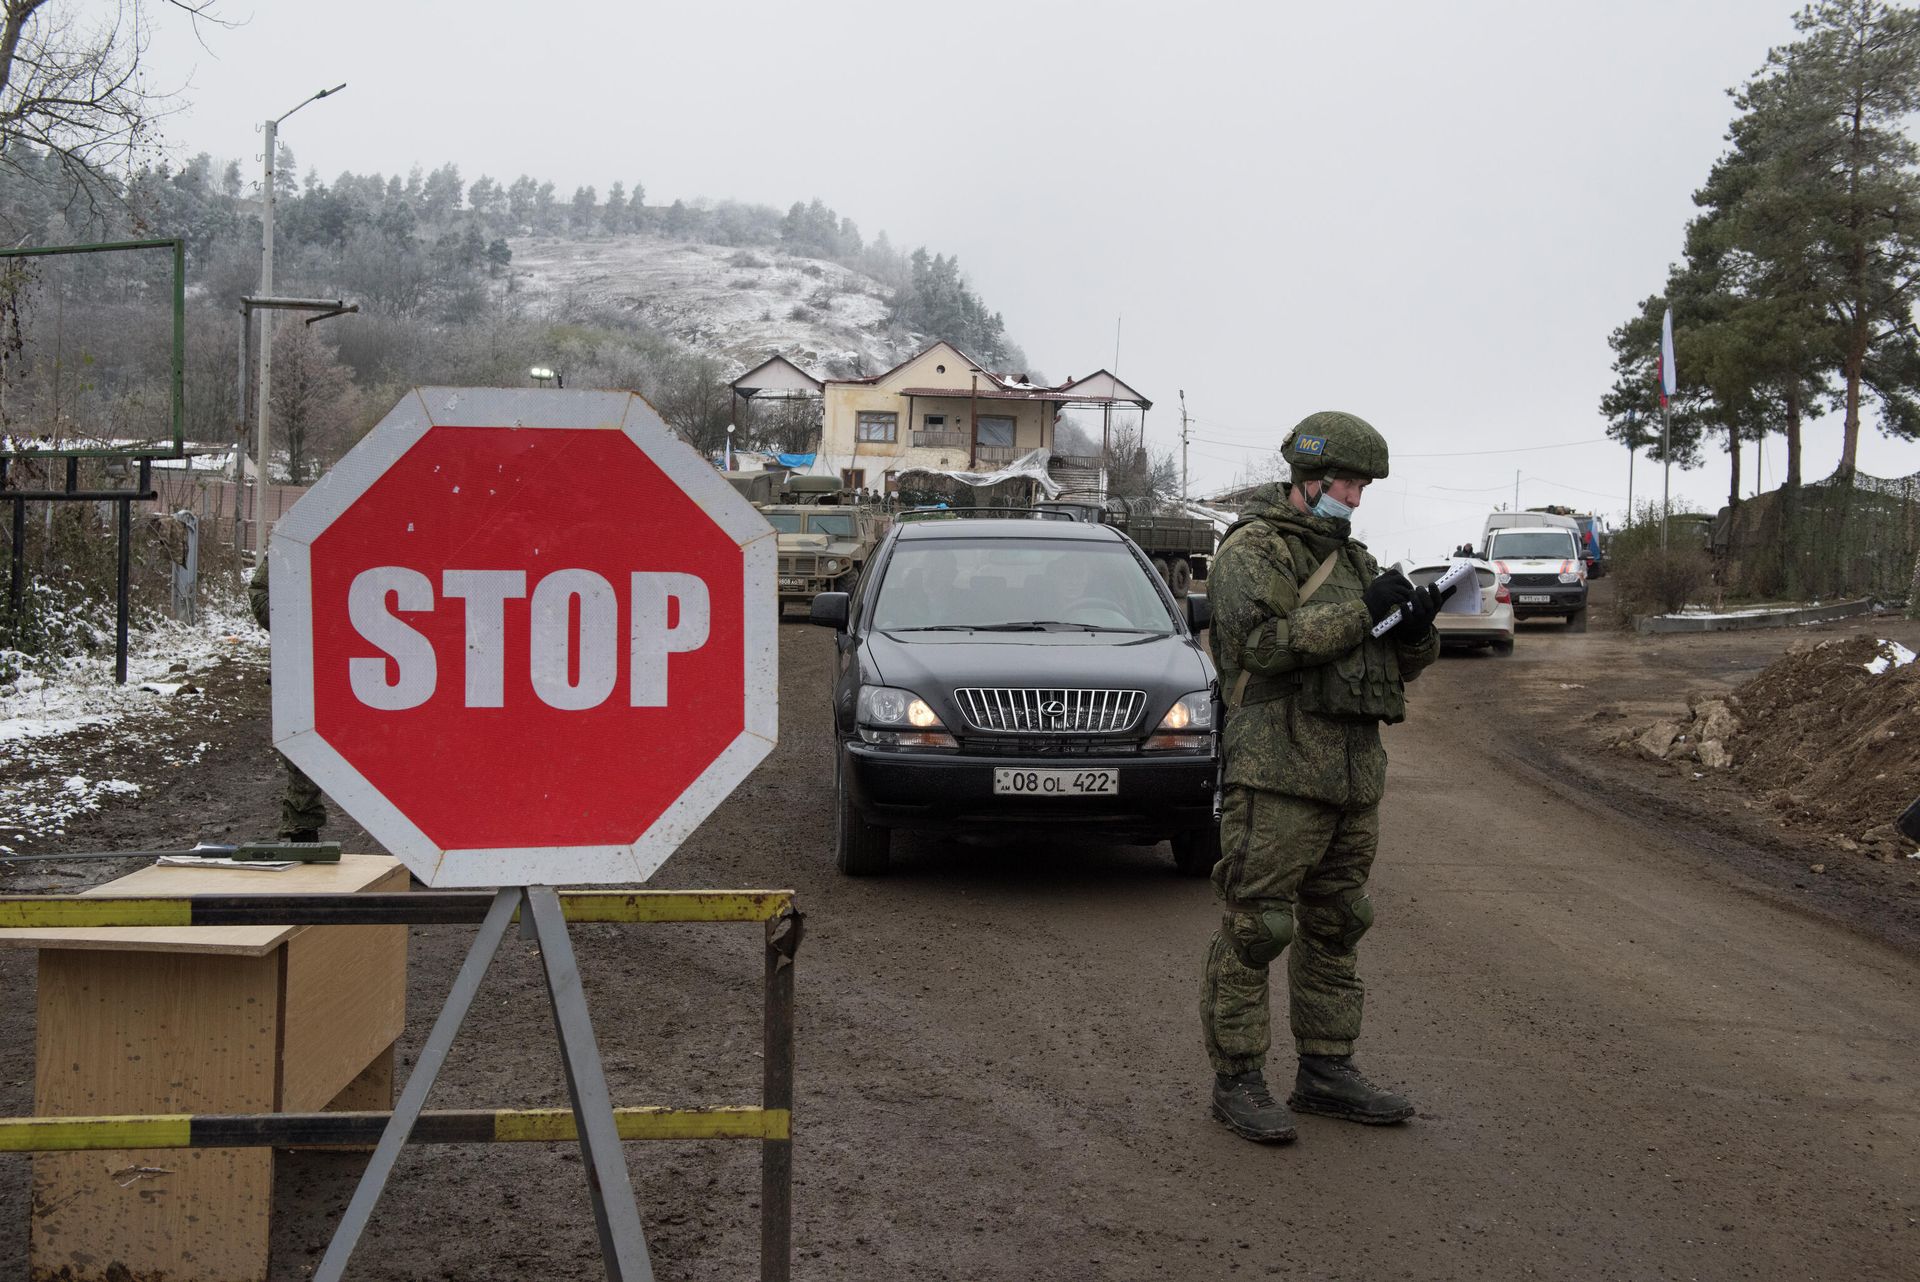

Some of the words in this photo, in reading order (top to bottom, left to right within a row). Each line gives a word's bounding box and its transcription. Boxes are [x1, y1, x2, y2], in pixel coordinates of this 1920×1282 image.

[348, 565, 711, 711] STOP
[1013, 772, 1039, 792] 08
[1043, 777, 1066, 792] OL
[1073, 772, 1110, 792] 422
